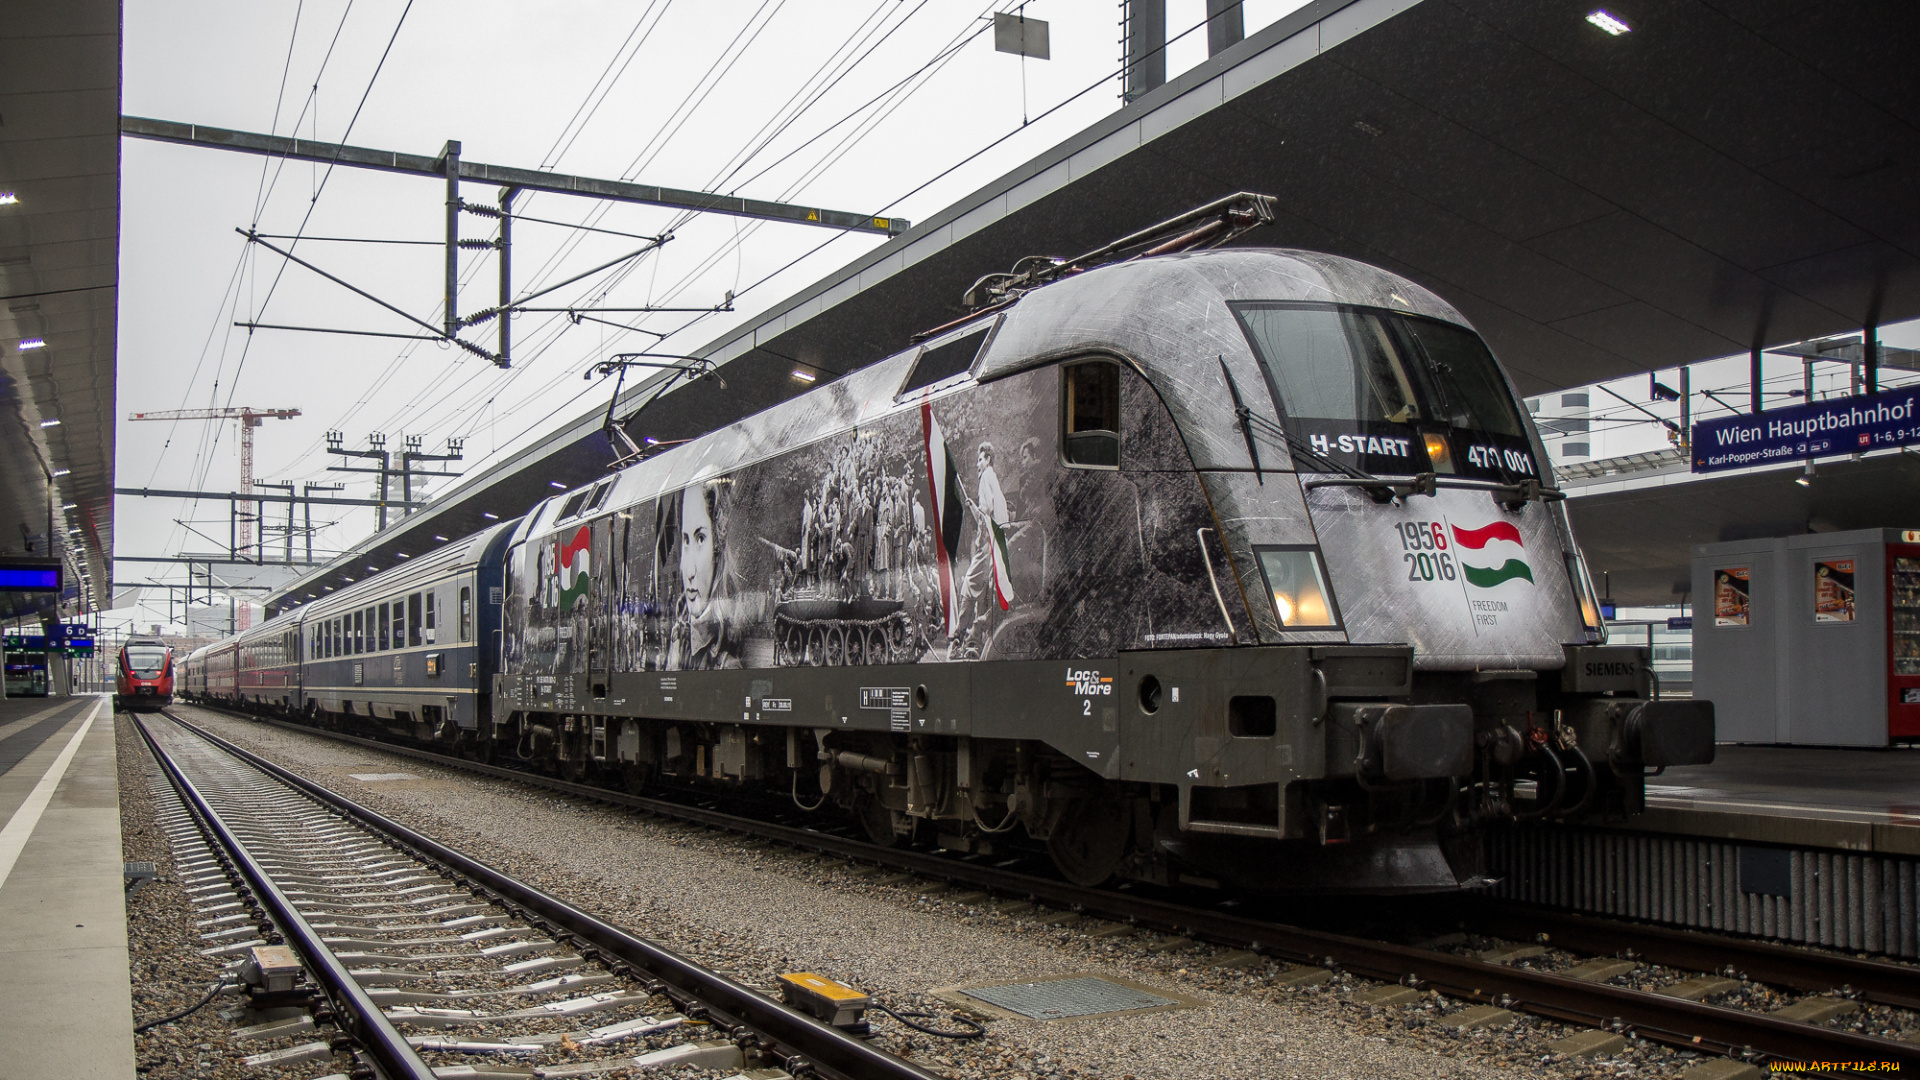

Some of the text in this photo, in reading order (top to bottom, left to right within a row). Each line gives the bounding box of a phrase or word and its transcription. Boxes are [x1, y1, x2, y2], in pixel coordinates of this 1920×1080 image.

[1716, 397, 1915, 446] Wien Hauptbahnhof
[1859, 435, 1869, 444] U1
[1309, 434, 1409, 457] H-START
[1503, 449, 1534, 475] 001
[1708, 446, 1793, 466] Karl-Popper-Straße
[1394, 521, 1447, 551] 1956
[1403, 552, 1456, 582] 2016
[1472, 600, 1508, 612] FREEDOM
[1476, 614, 1498, 625] FIRST
[1066, 667, 1100, 684] Loc&
[1585, 662, 1635, 676] SIEMENS
[1074, 681, 1112, 695] More
[1083, 699, 1091, 716] 2
